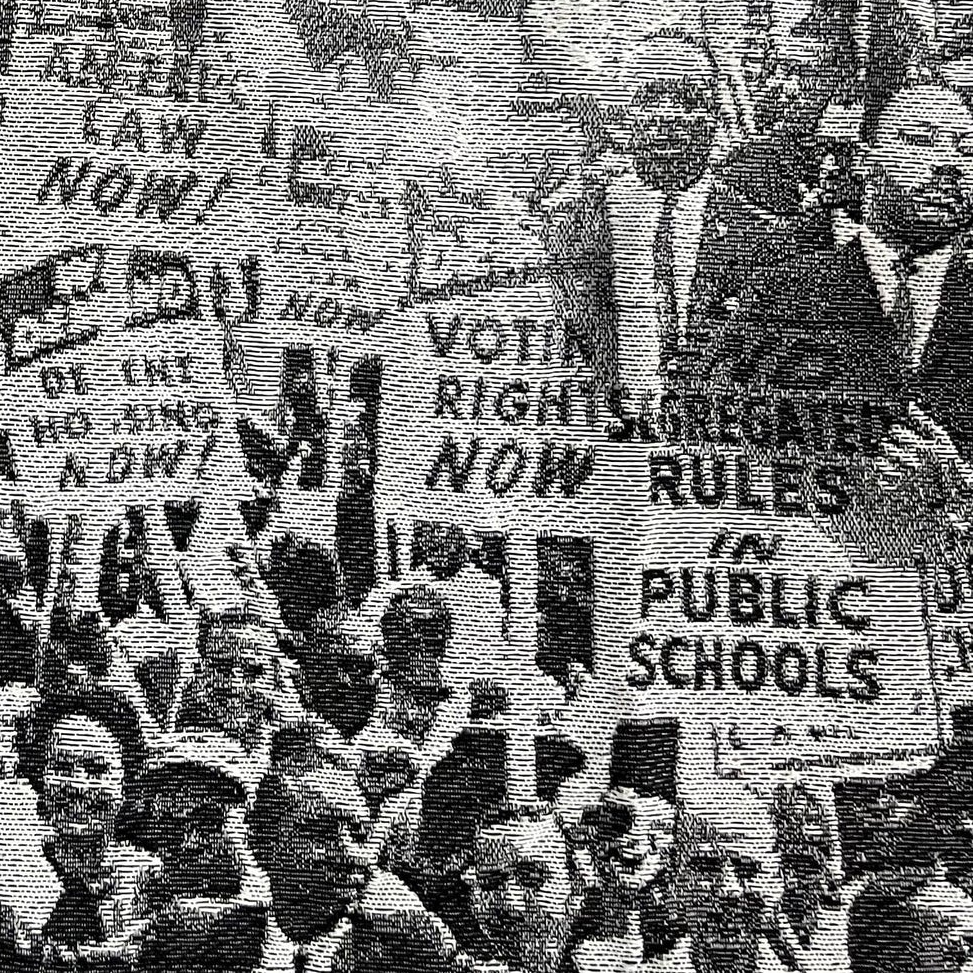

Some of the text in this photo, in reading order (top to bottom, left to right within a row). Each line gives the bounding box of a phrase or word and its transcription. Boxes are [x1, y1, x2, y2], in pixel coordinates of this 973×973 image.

[36, 157, 234, 222] NOW!
[424, 435, 598, 499] NOW
[648, 454, 853, 516] RULES
[640, 568, 872, 629] PUBLIC
[627, 633, 881, 702] SCHOOLS
